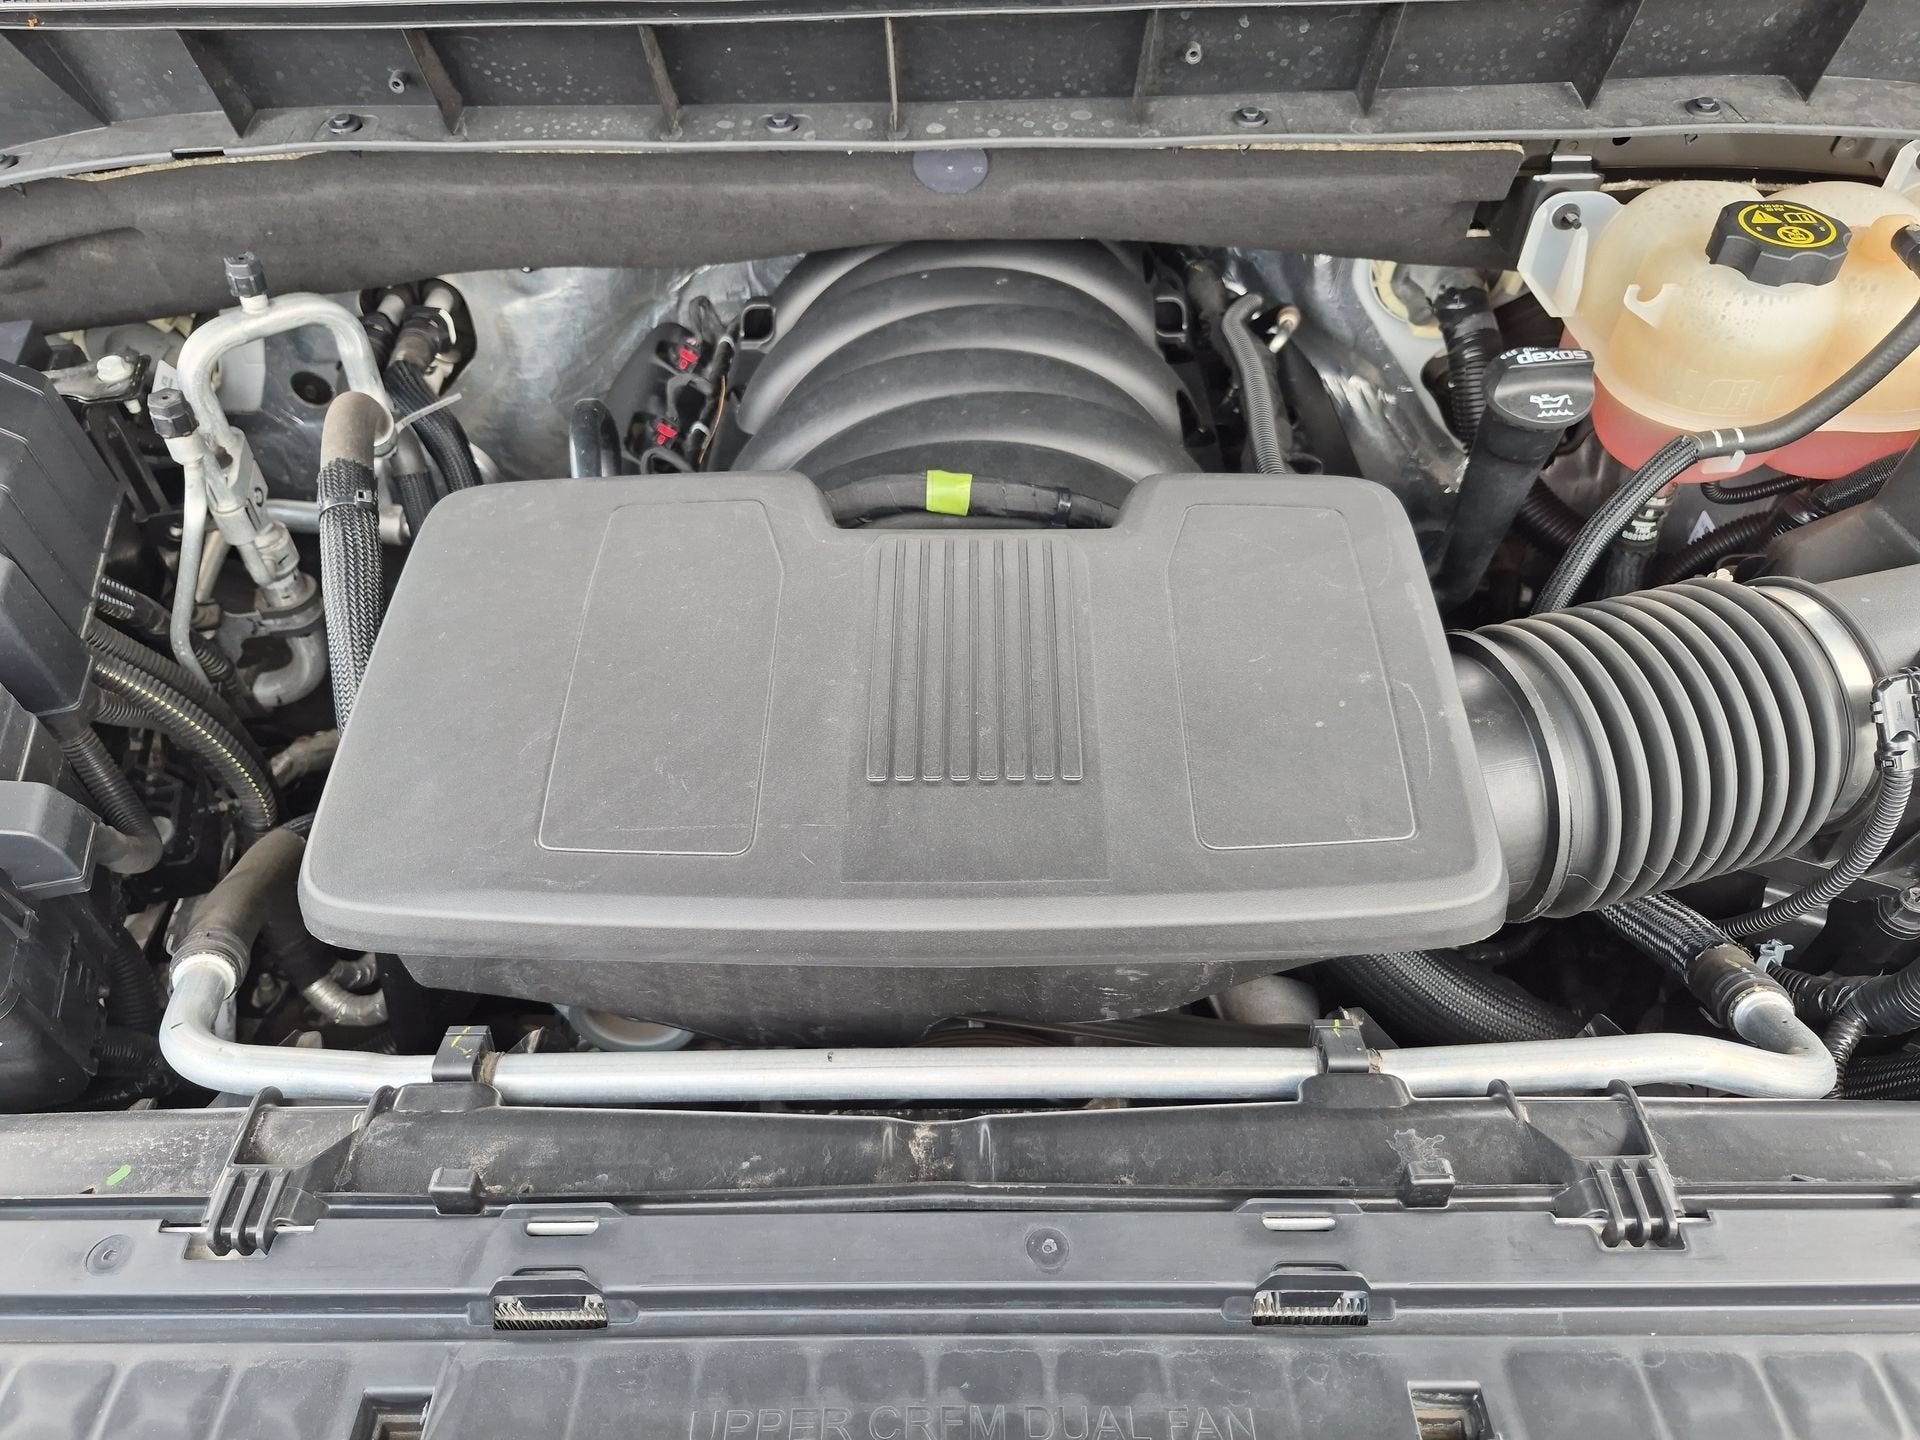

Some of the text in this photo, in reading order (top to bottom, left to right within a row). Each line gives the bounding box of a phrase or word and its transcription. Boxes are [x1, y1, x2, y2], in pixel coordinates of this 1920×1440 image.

[1516, 350, 1588, 364] dexos
[689, 1404, 1258, 1440] UPPER CRFM DUAL FAN
